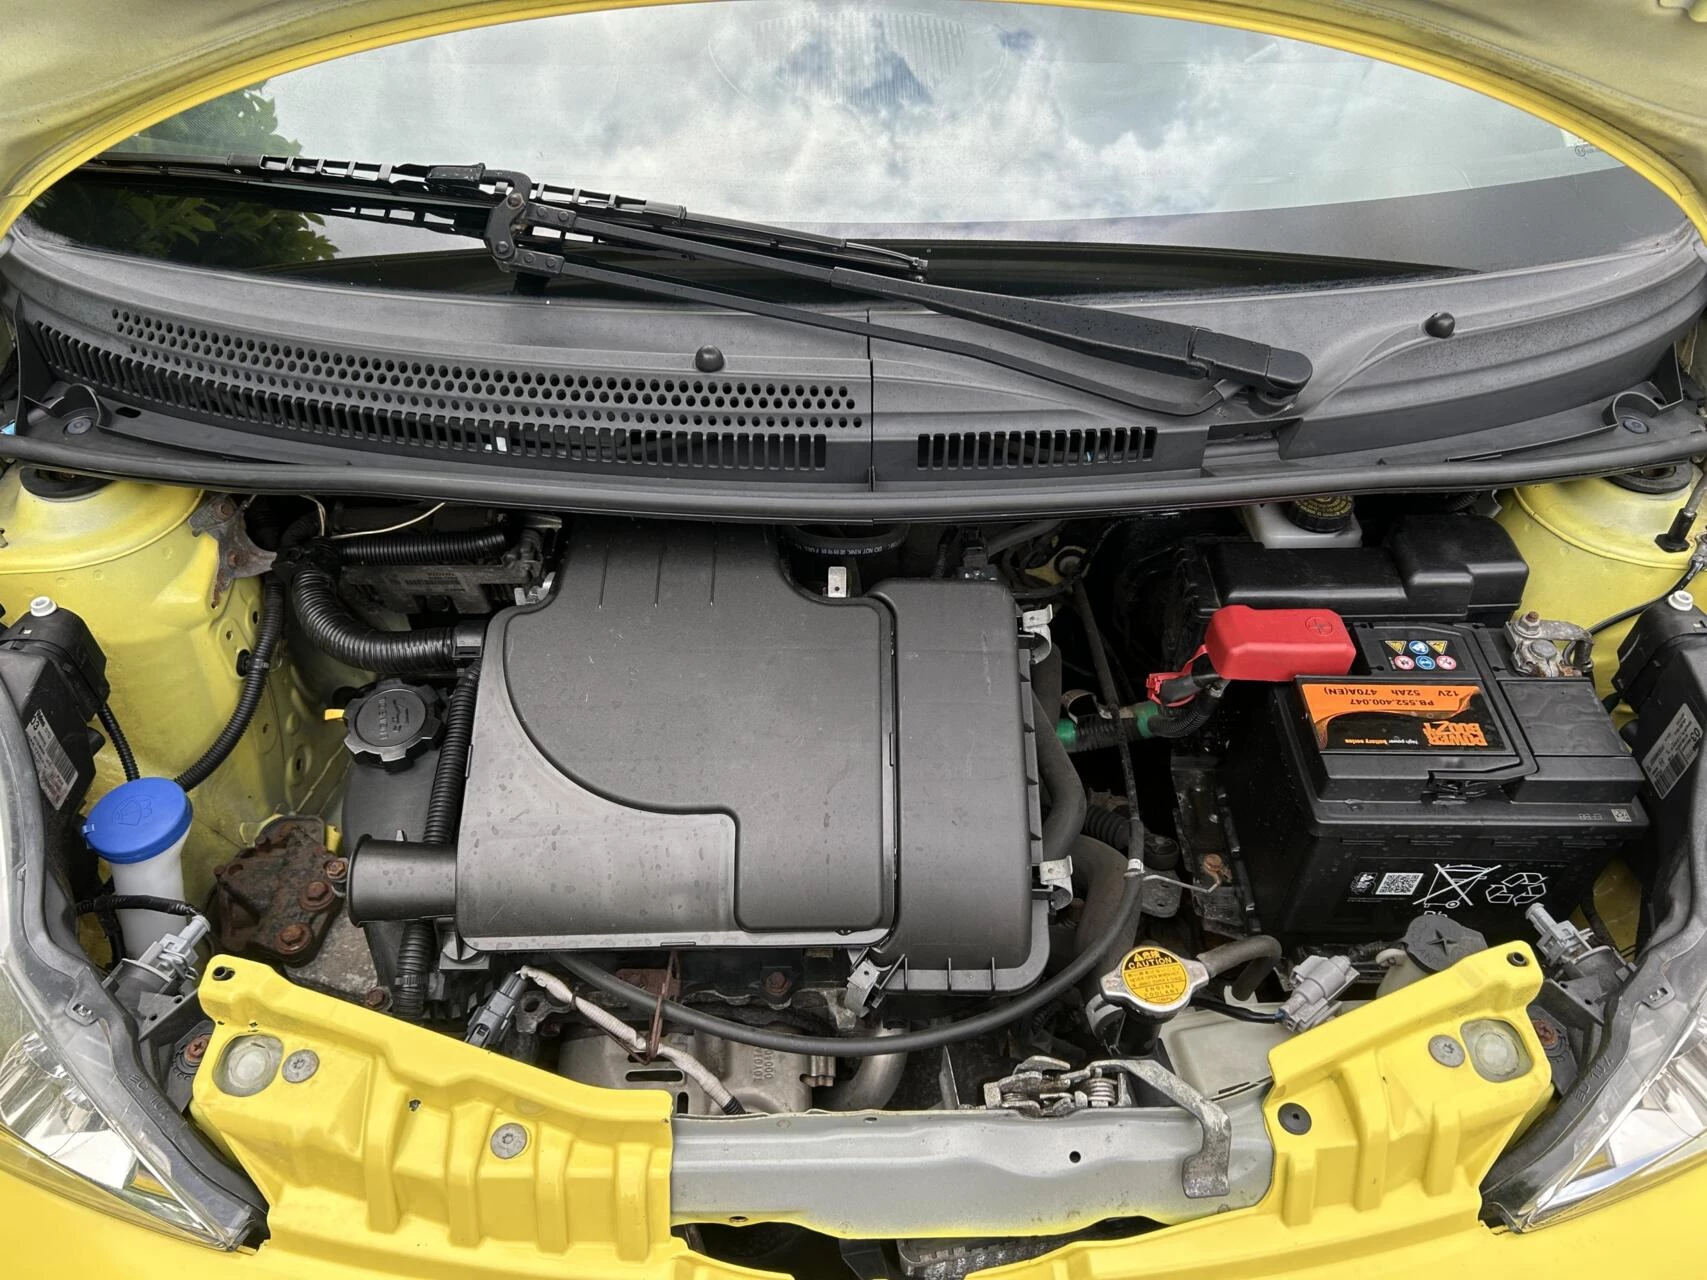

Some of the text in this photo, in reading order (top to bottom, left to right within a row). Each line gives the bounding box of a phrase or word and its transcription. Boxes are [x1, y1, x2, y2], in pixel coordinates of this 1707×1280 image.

[1323, 687, 1459, 697] 12V 52Ah 470A(EN)
[1350, 698, 1435, 706] PB.552.400.047
[1428, 732, 1488, 747] POWER
[1690, 727, 1701, 742] 03
[1365, 738, 1389, 746] battery
[1128, 957, 1172, 970] CAUTION
